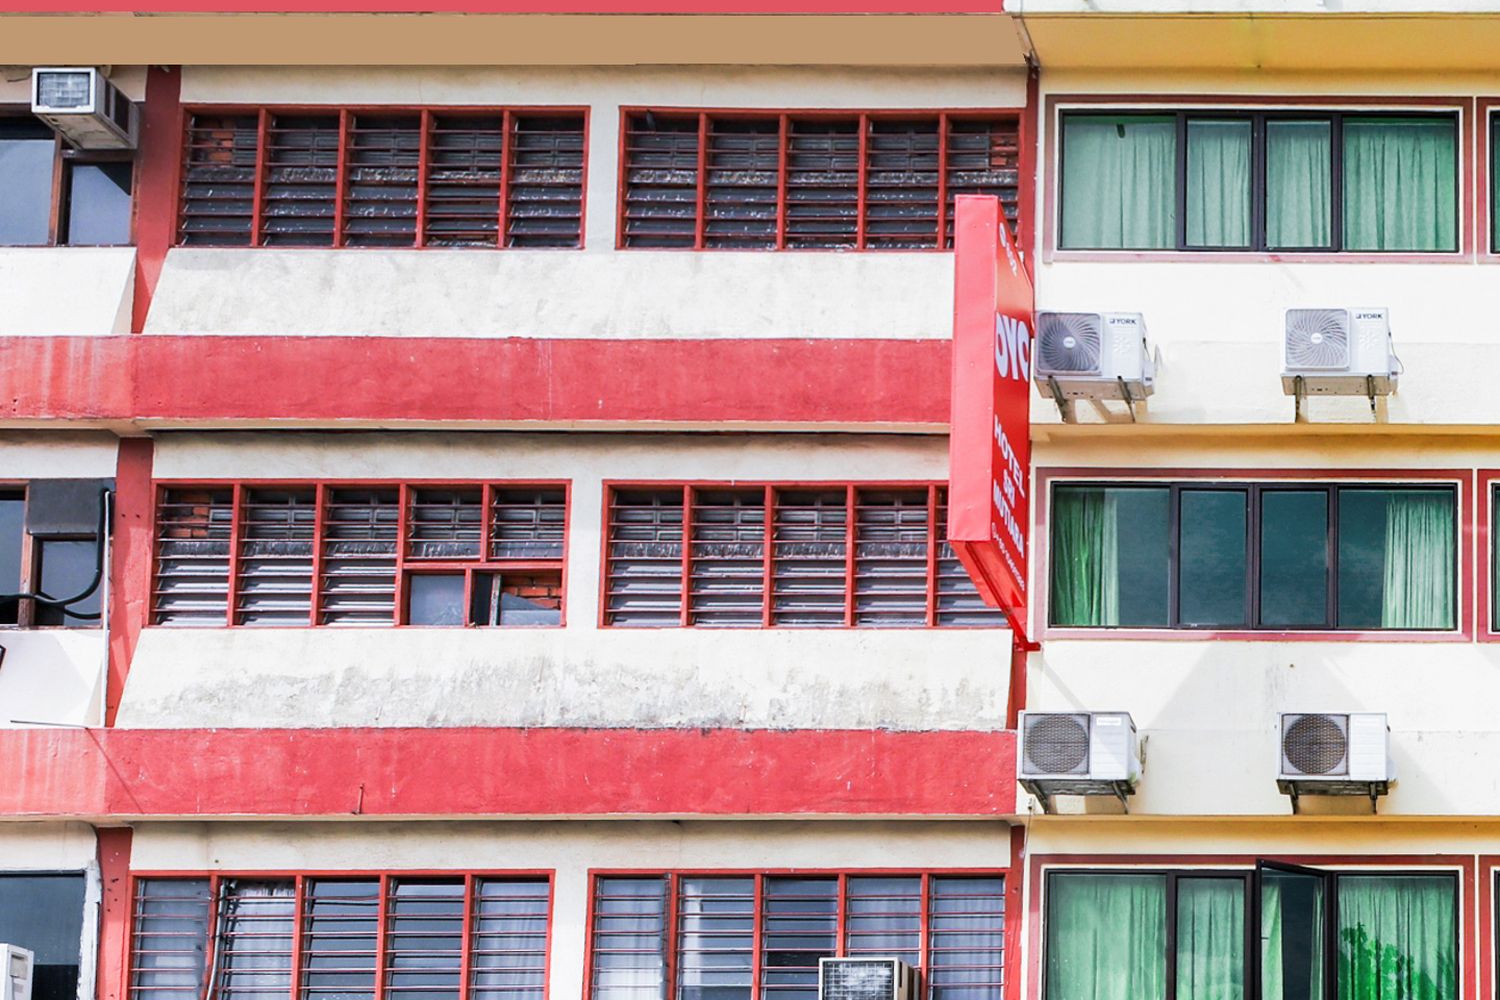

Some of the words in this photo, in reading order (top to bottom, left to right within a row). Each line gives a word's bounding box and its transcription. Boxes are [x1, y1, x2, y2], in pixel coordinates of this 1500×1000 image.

[994, 311, 1030, 382] OYO
[994, 413, 1026, 499] HOTEL
[993, 478, 1025, 558] MUTIARA
